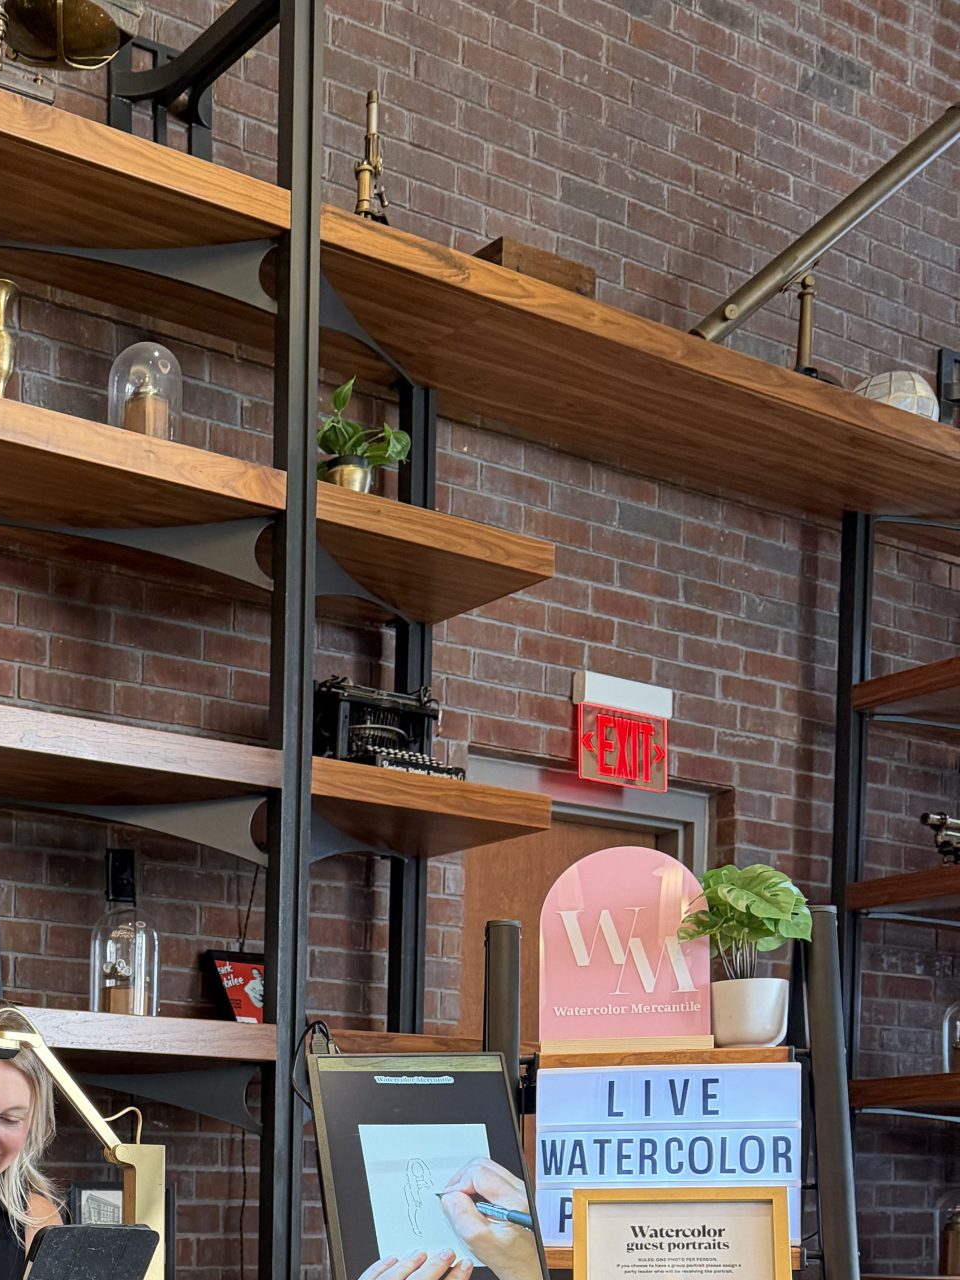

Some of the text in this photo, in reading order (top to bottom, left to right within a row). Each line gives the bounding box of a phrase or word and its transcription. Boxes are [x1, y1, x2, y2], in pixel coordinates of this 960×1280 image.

[597, 713, 655, 783] EXIT
[553, 1001, 701, 1017] Watercolor Mercantile
[607, 1077, 720, 1117] LIVE
[540, 1135, 793, 1176] WATERCOLOR
[626, 1238, 730, 1253] guest portraits
[630, 1224, 727, 1239] Watercolor
